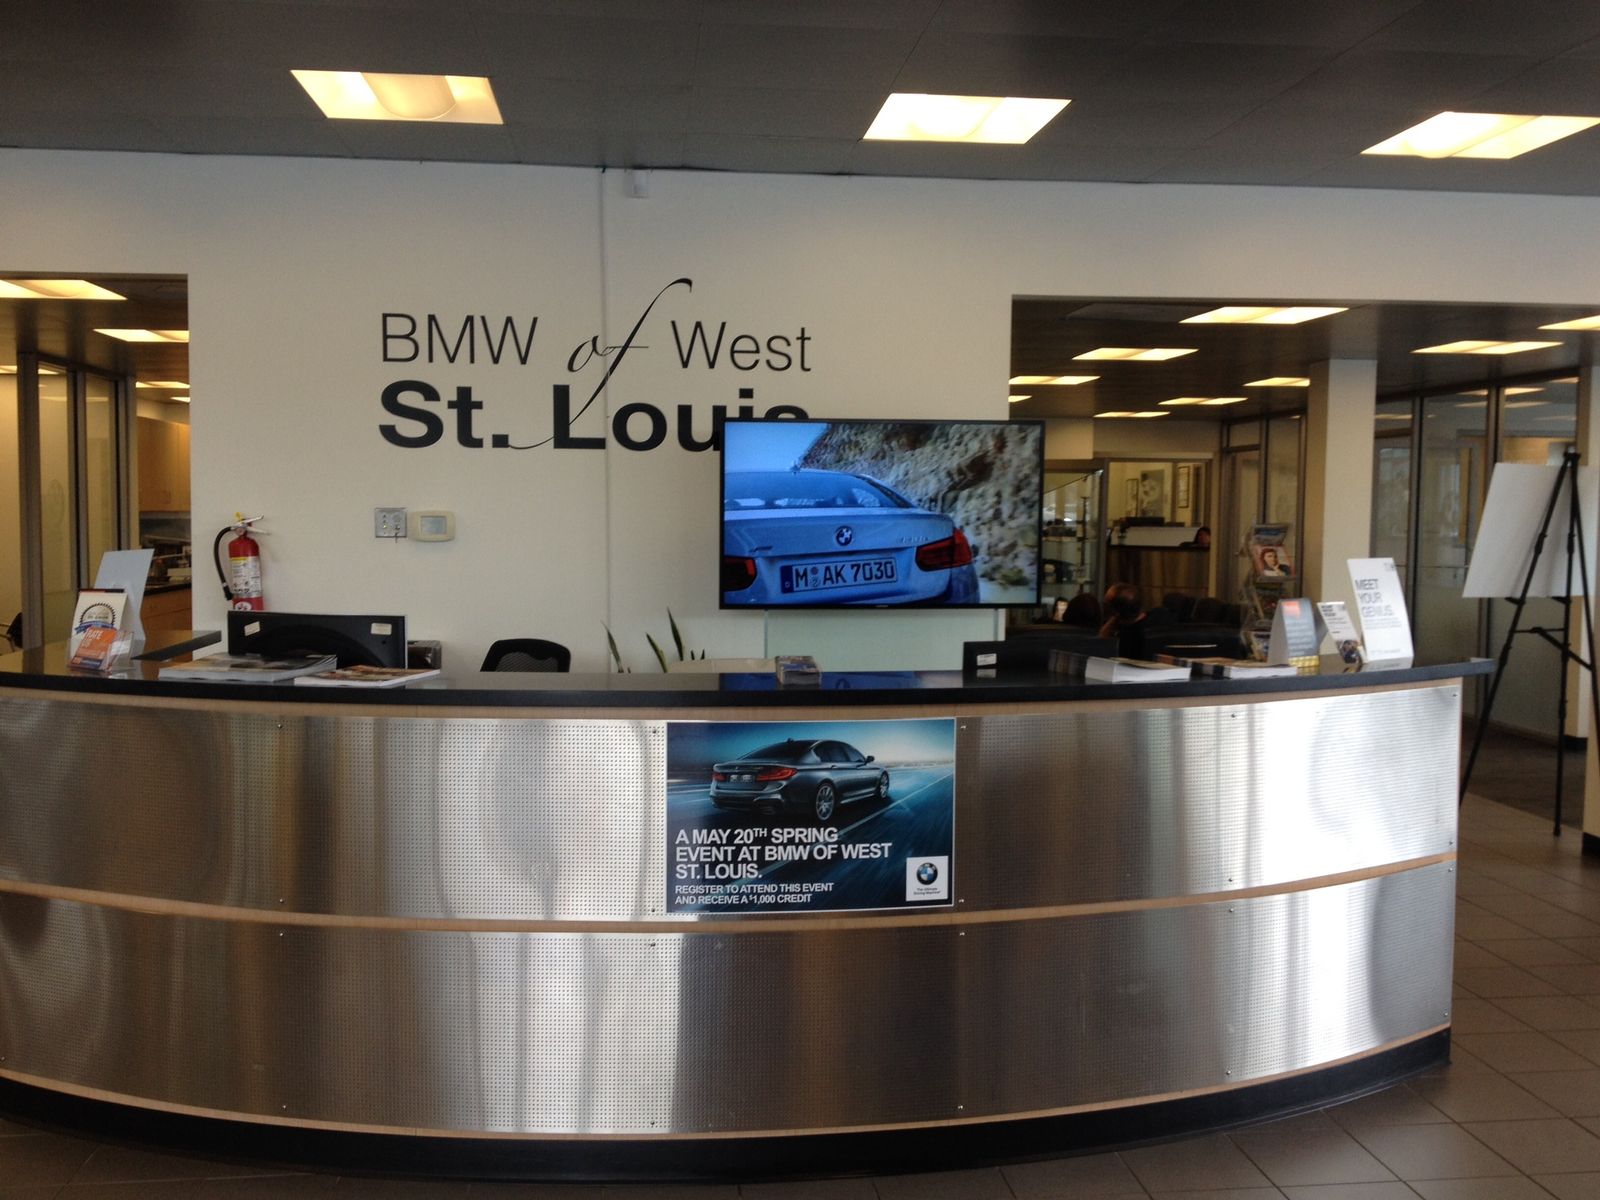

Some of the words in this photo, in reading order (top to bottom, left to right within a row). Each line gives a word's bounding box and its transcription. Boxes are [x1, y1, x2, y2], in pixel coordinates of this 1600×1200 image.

[381, 312, 538, 365] BMW
[545, 278, 692, 443] of
[671, 319, 811, 372] West
[379, 380, 509, 449] St.
[553, 384, 809, 452] Loui
[823, 564, 847, 585] AK
[851, 561, 895, 581] 7030
[1355, 579, 1379, 590] MEET
[675, 829, 689, 844] A
[693, 829, 731, 844] MAY
[734, 828, 767, 844] 20TH
[771, 827, 838, 843] SPRING
[676, 846, 735, 861] EVENT
[738, 846, 761, 861] AT
[765, 845, 810, 860] BMW
[813, 844, 838, 859] OF
[841, 843, 892, 859] WEST
[676, 864, 700, 879] ST.
[705, 863, 762, 879] LOUIS.
[675, 885, 723, 894] REGISTER
[725, 885, 739, 893] TO
[740, 884, 777, 893] ATTEND
[780, 883, 800, 892] THIS
[803, 883, 834, 892] EVENT
[675, 896, 696, 904] AND
[698, 895, 739, 904] RECEIVE
[741, 895, 748, 903] A
[749, 895, 775, 904] $1,000
[777, 894, 812, 903] CREDIT
